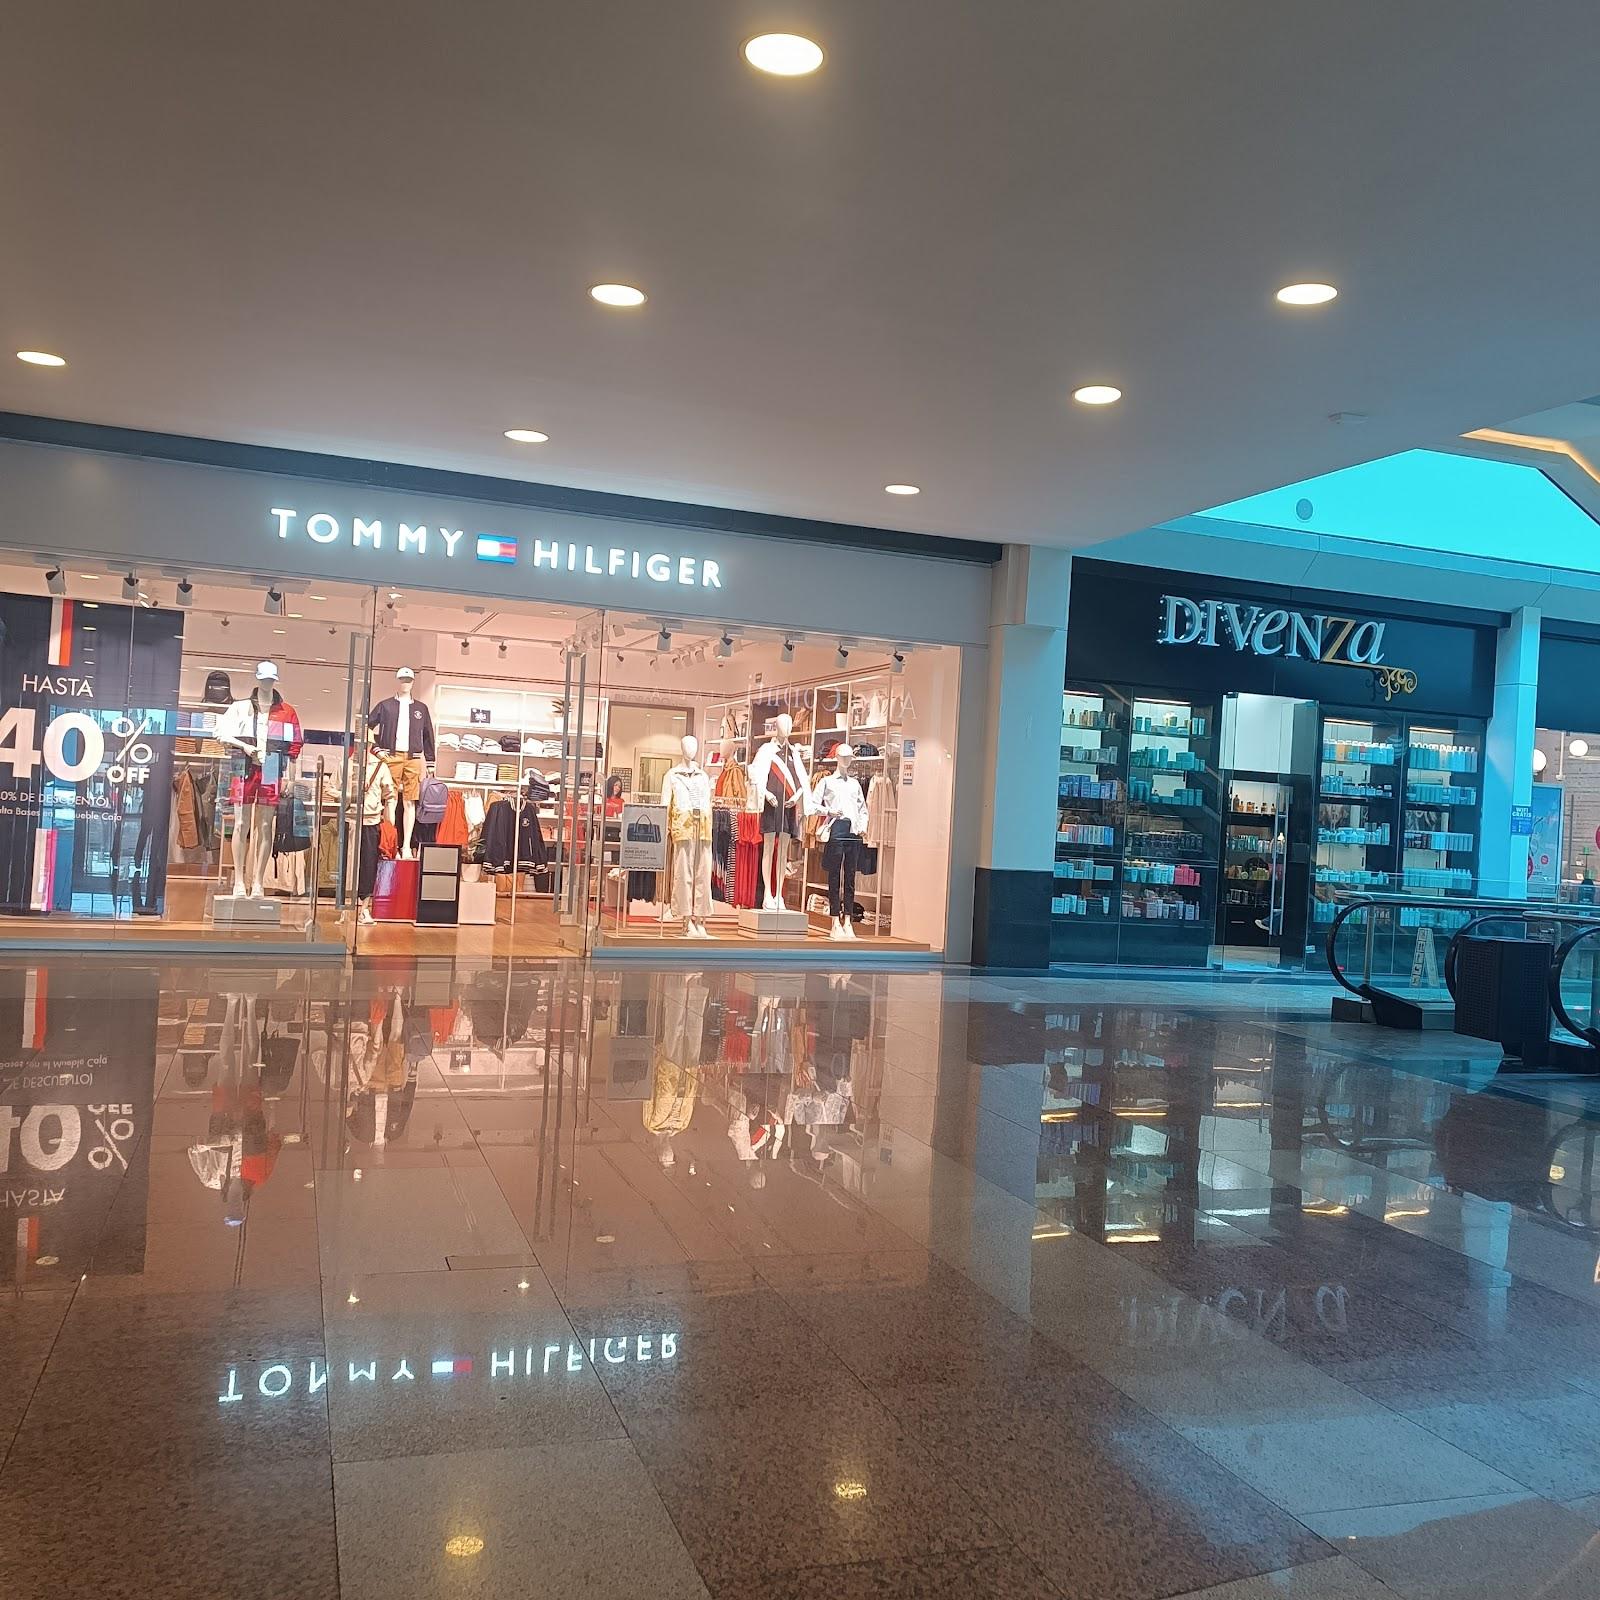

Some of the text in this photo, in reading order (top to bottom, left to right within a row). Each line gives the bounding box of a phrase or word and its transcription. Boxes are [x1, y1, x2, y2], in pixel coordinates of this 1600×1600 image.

[270, 507, 723, 588] TOMMY HILFIGER
[22, 674, 94, 698] HASTA
[107, 765, 150, 784] OFF
[20, 792, 36, 803] DE
[16, 807, 40, 817] Bases
